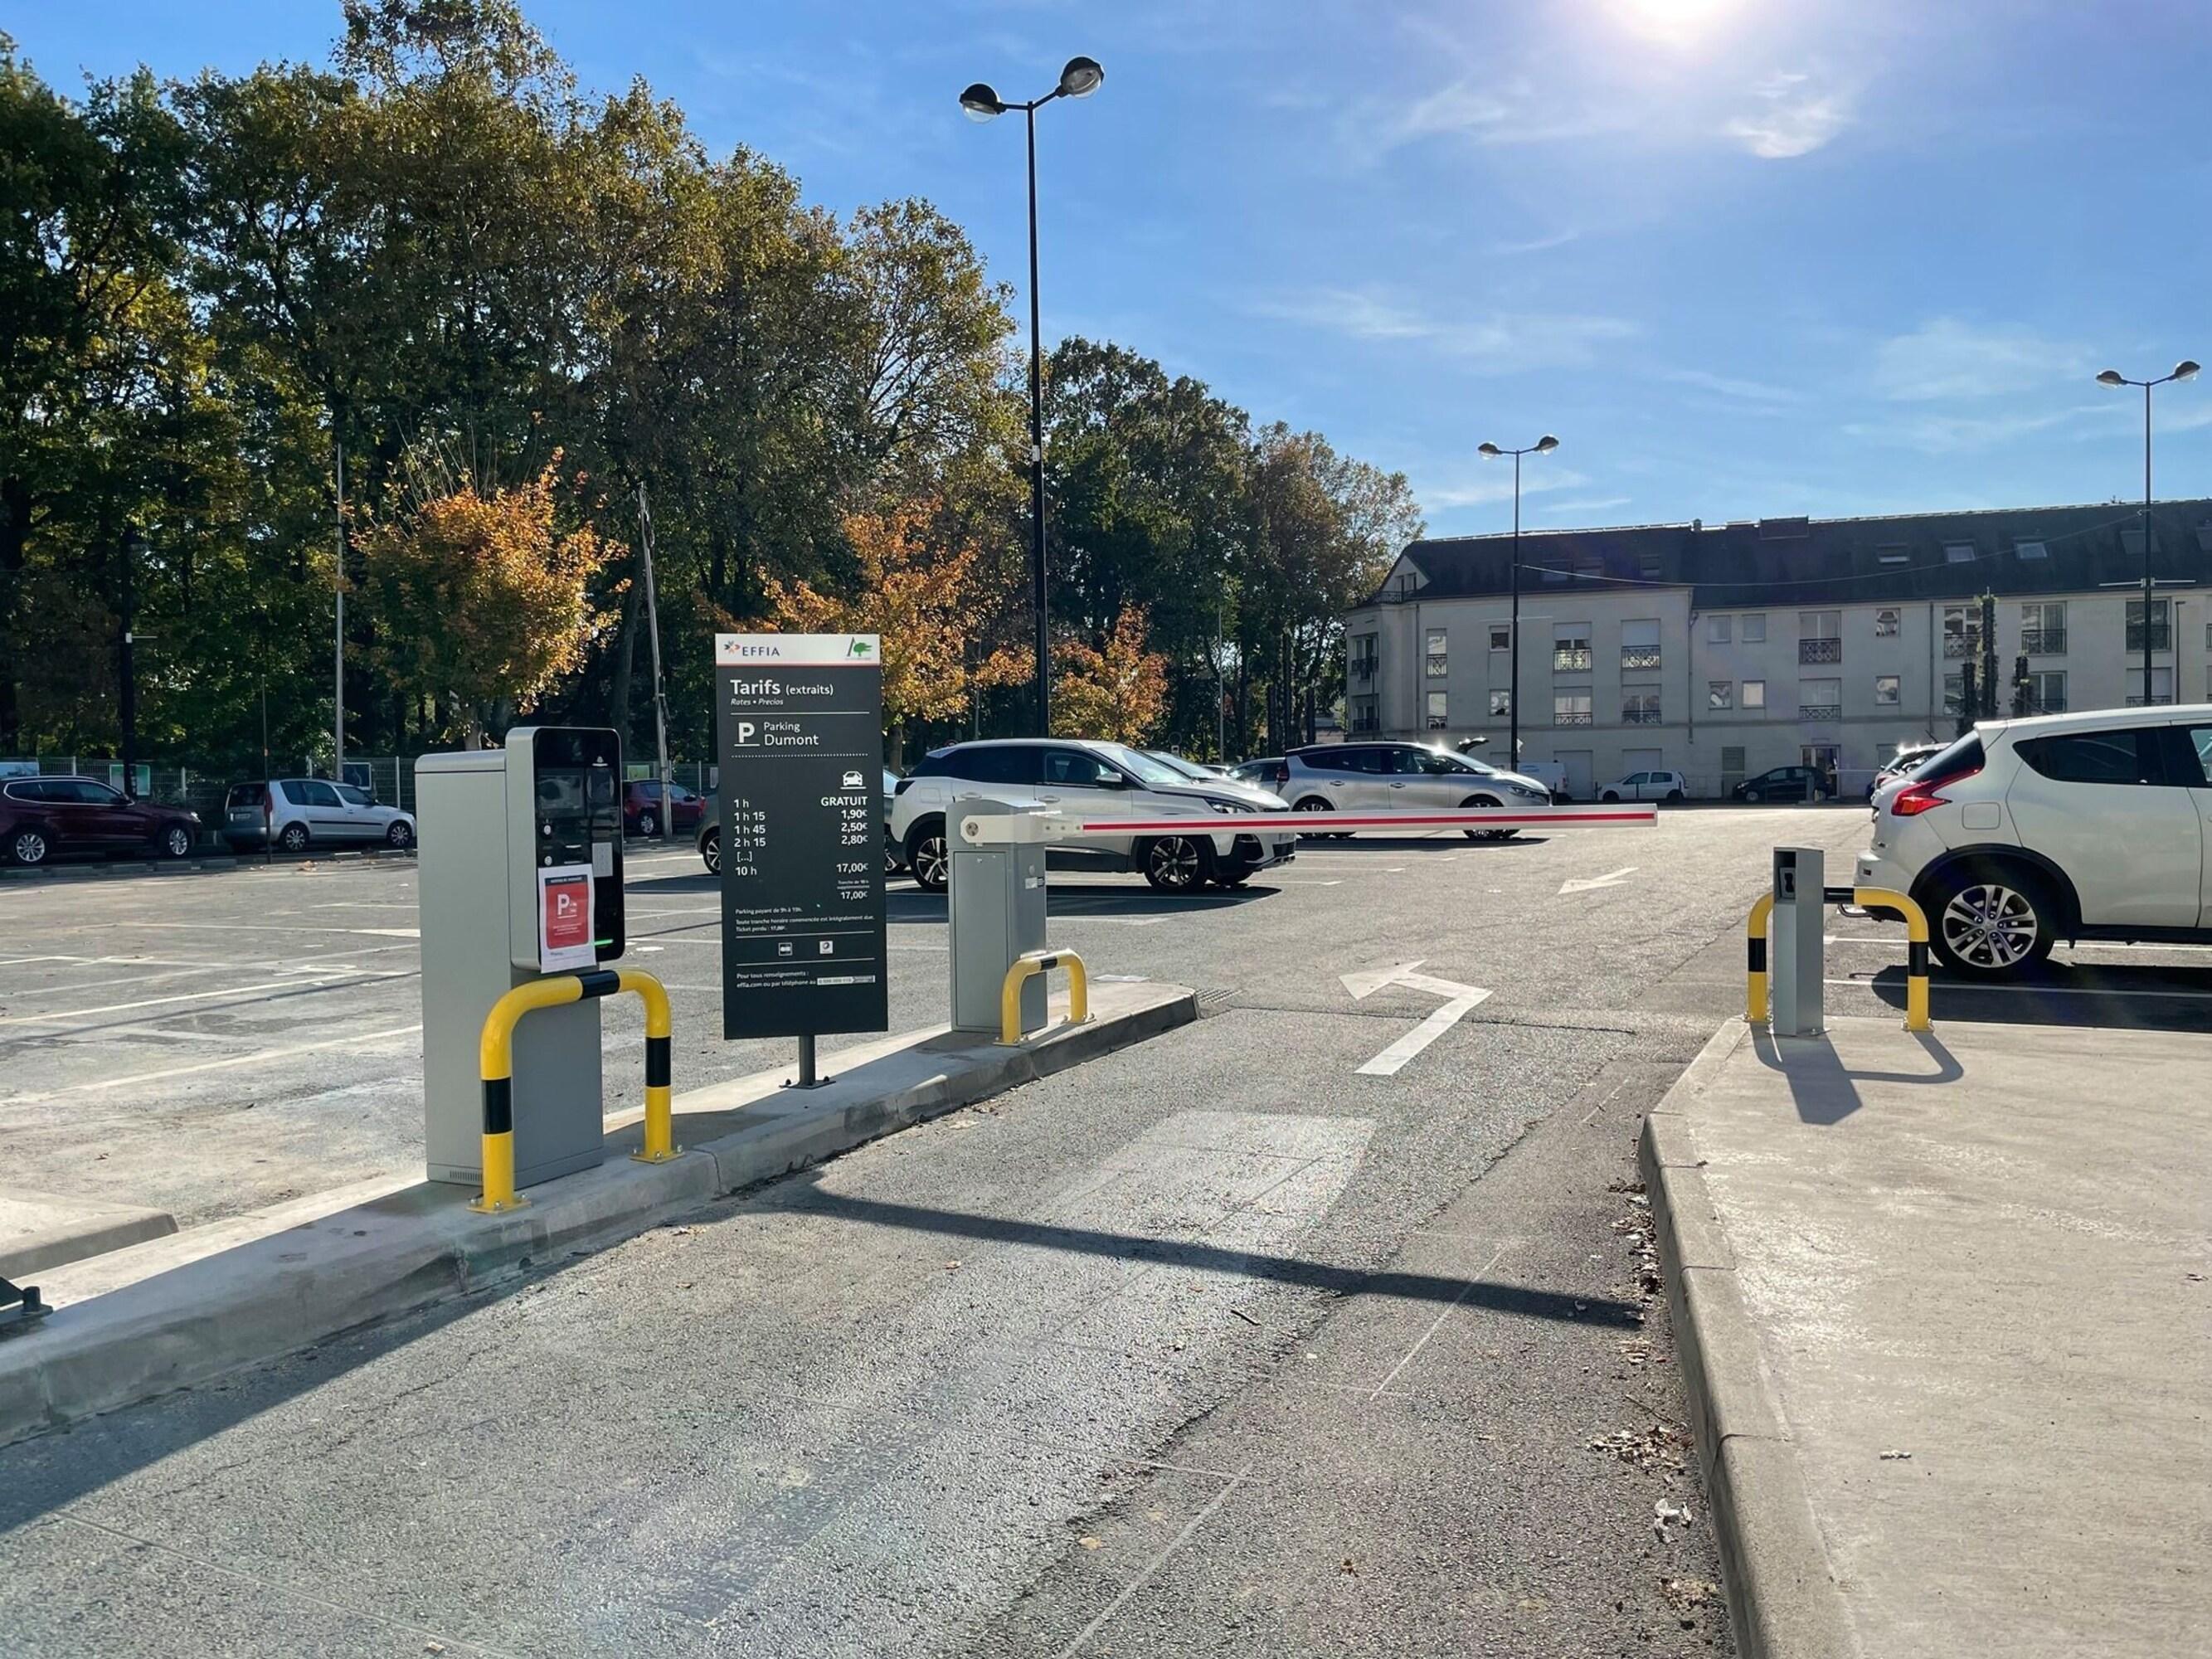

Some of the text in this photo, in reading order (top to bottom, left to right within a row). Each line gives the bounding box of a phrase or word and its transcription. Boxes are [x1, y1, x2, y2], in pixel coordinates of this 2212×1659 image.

[742, 646, 780, 656] EFFIA
[730, 679, 834, 695] Tarifs (extraits)
[758, 698, 784, 706] Precios
[764, 722, 800, 732] Parking
[738, 722, 756, 744] P
[764, 734, 819, 746] Dumont
[734, 798, 750, 808] 1 h
[820, 796, 868, 806] GRATUIT
[734, 811, 766, 821] 1 h 15
[841, 810, 868, 820] 1,90€
[734, 825, 766, 834] 1 h 45
[841, 823, 868, 833] 2,50€
[734, 838, 766, 848] 2 h 15
[841, 835, 868, 846] 2,80€
[736, 866, 757, 876] 10 h
[836, 863, 868, 874] 17,00€
[841, 891, 868, 900] 17,00€
